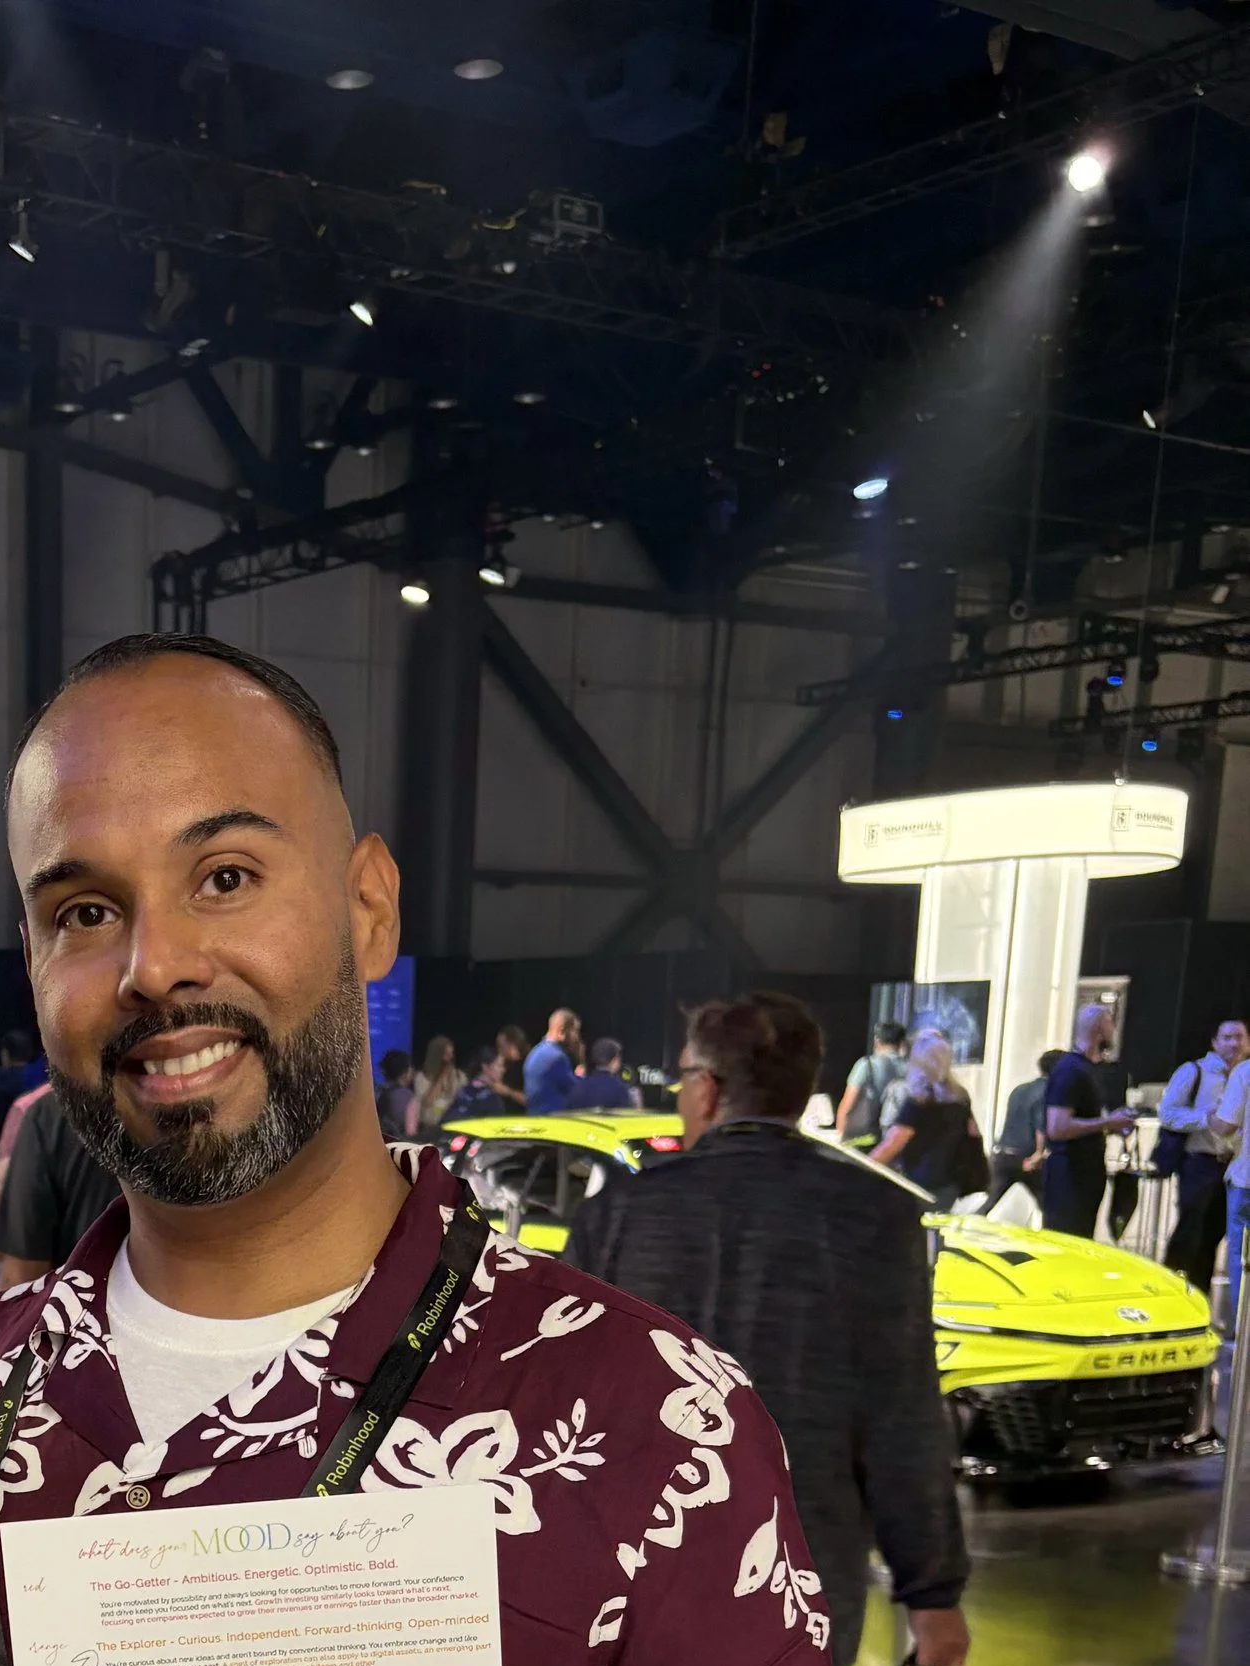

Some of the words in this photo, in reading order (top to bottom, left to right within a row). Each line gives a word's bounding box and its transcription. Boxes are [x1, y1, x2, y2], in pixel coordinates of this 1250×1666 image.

[416, 1270, 460, 1337] Robinhood
[326, 1410, 380, 1486] Robinhood
[78, 1539, 120, 1560] what
[192, 1523, 291, 1556] MOOD
[293, 1529, 325, 1558] say
[329, 1518, 374, 1540] about
[22, 1577, 47, 1594] red
[88, 1580, 112, 1592] The
[113, 1576, 171, 1590] Go-Getter
[180, 1571, 242, 1585] Ambitious.
[243, 1565, 302, 1581] Energetic.
[367, 1557, 399, 1571] Bold.
[93, 1640, 118, 1657] The
[119, 1638, 167, 1651] Explorer
[225, 1626, 302, 1643] Independent.
[406, 1612, 490, 1631] Open-minded
